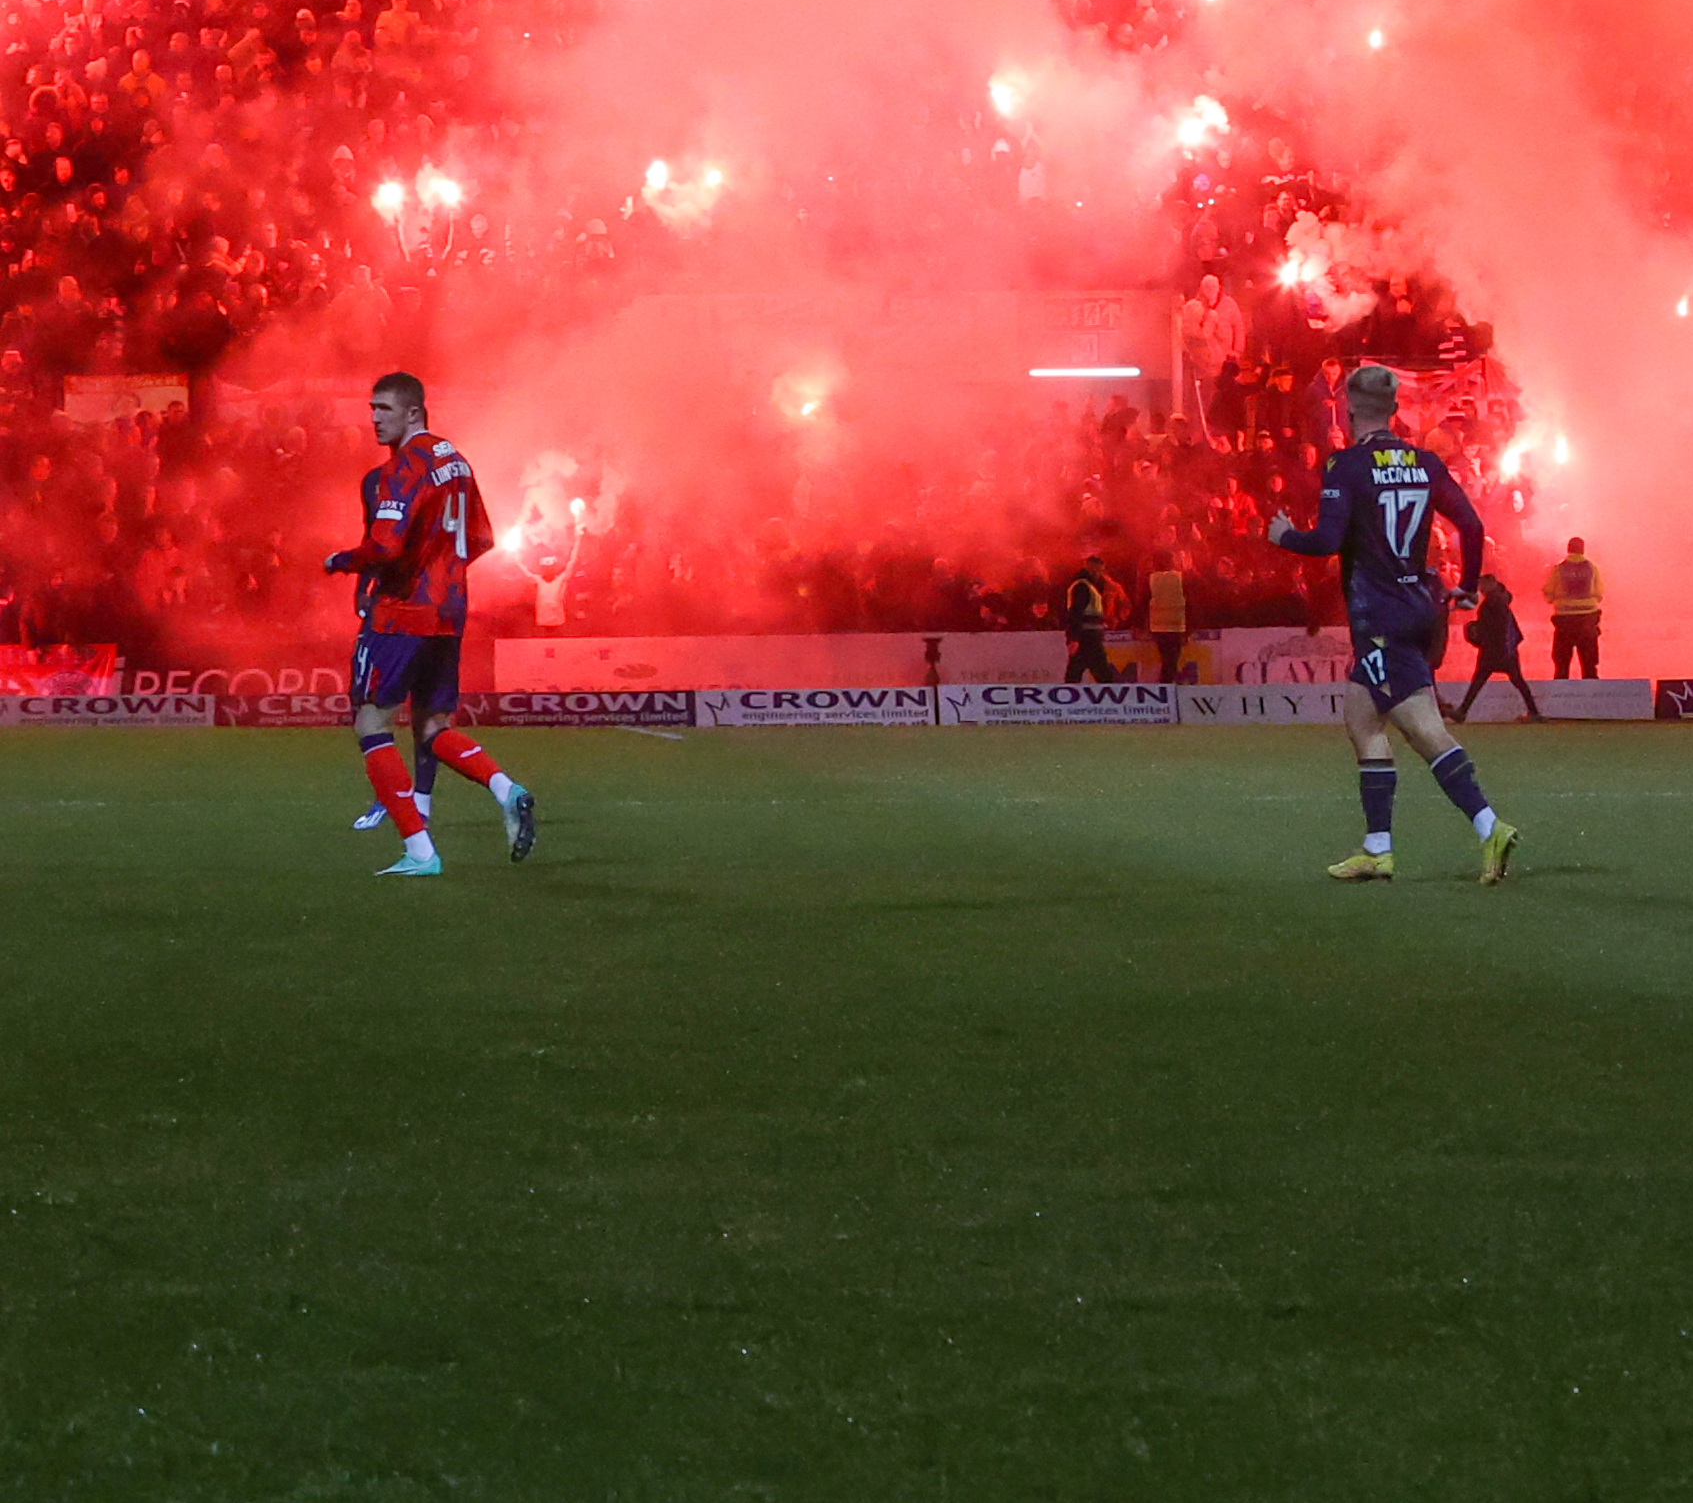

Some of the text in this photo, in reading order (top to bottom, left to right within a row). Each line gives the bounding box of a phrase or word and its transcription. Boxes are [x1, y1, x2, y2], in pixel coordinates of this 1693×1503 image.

[1372, 448, 1418, 468] MKM
[1371, 467, 1430, 486] McCOWAN
[442, 491, 469, 560] 4
[1377, 487, 1431, 559] 17
[1361, 648, 1387, 686] 17
[19, 696, 207, 715] CROWN
[258, 694, 351, 714] CRO
[500, 692, 688, 713] CROWN
[739, 688, 928, 710] CROWN
[981, 685, 1169, 706] CROWN
[500, 709, 689, 725] engineering services limited
[741, 707, 929, 722] engineering services limited
[983, 703, 1171, 718] engineering services limited
